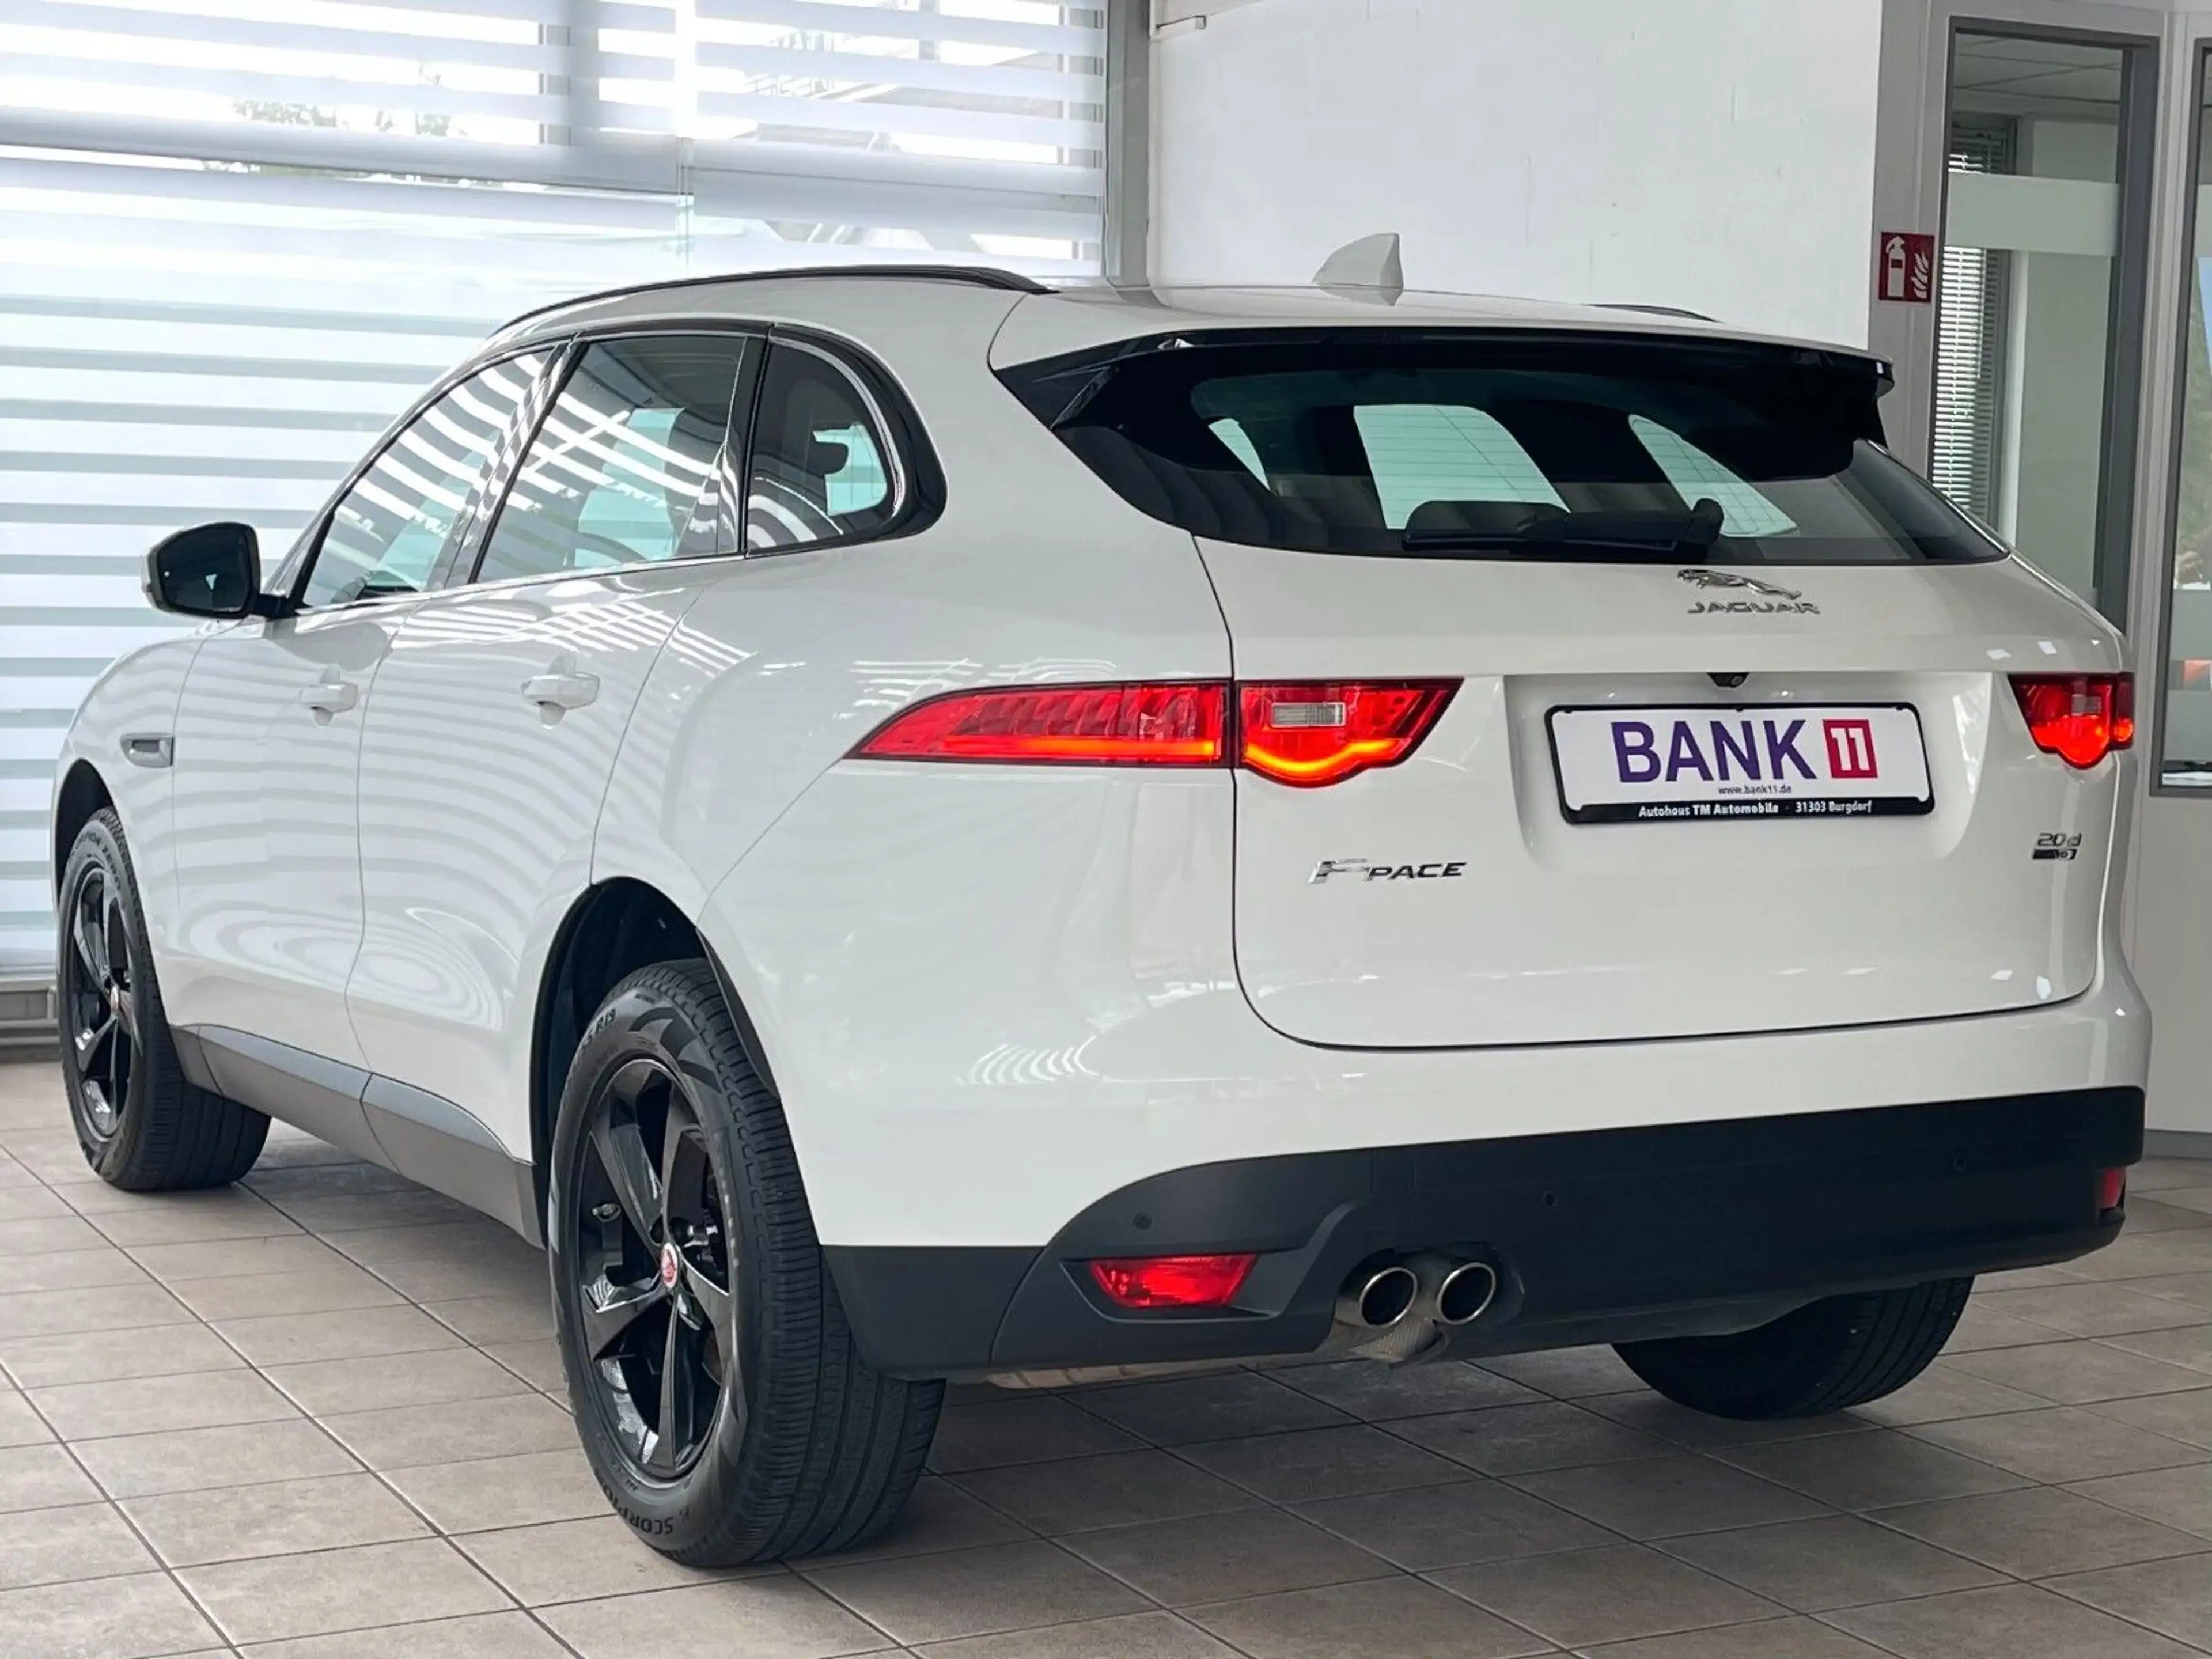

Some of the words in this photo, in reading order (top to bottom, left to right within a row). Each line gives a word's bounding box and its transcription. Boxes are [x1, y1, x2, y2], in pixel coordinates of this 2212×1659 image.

[1687, 601, 1820, 615] JAGUAR
[1611, 719, 1817, 782] BANK
[1692, 804, 1711, 816] TM
[1713, 801, 1779, 815] Automobile
[1795, 801, 1827, 813] 31303
[1828, 800, 1872, 814] Burgdorf
